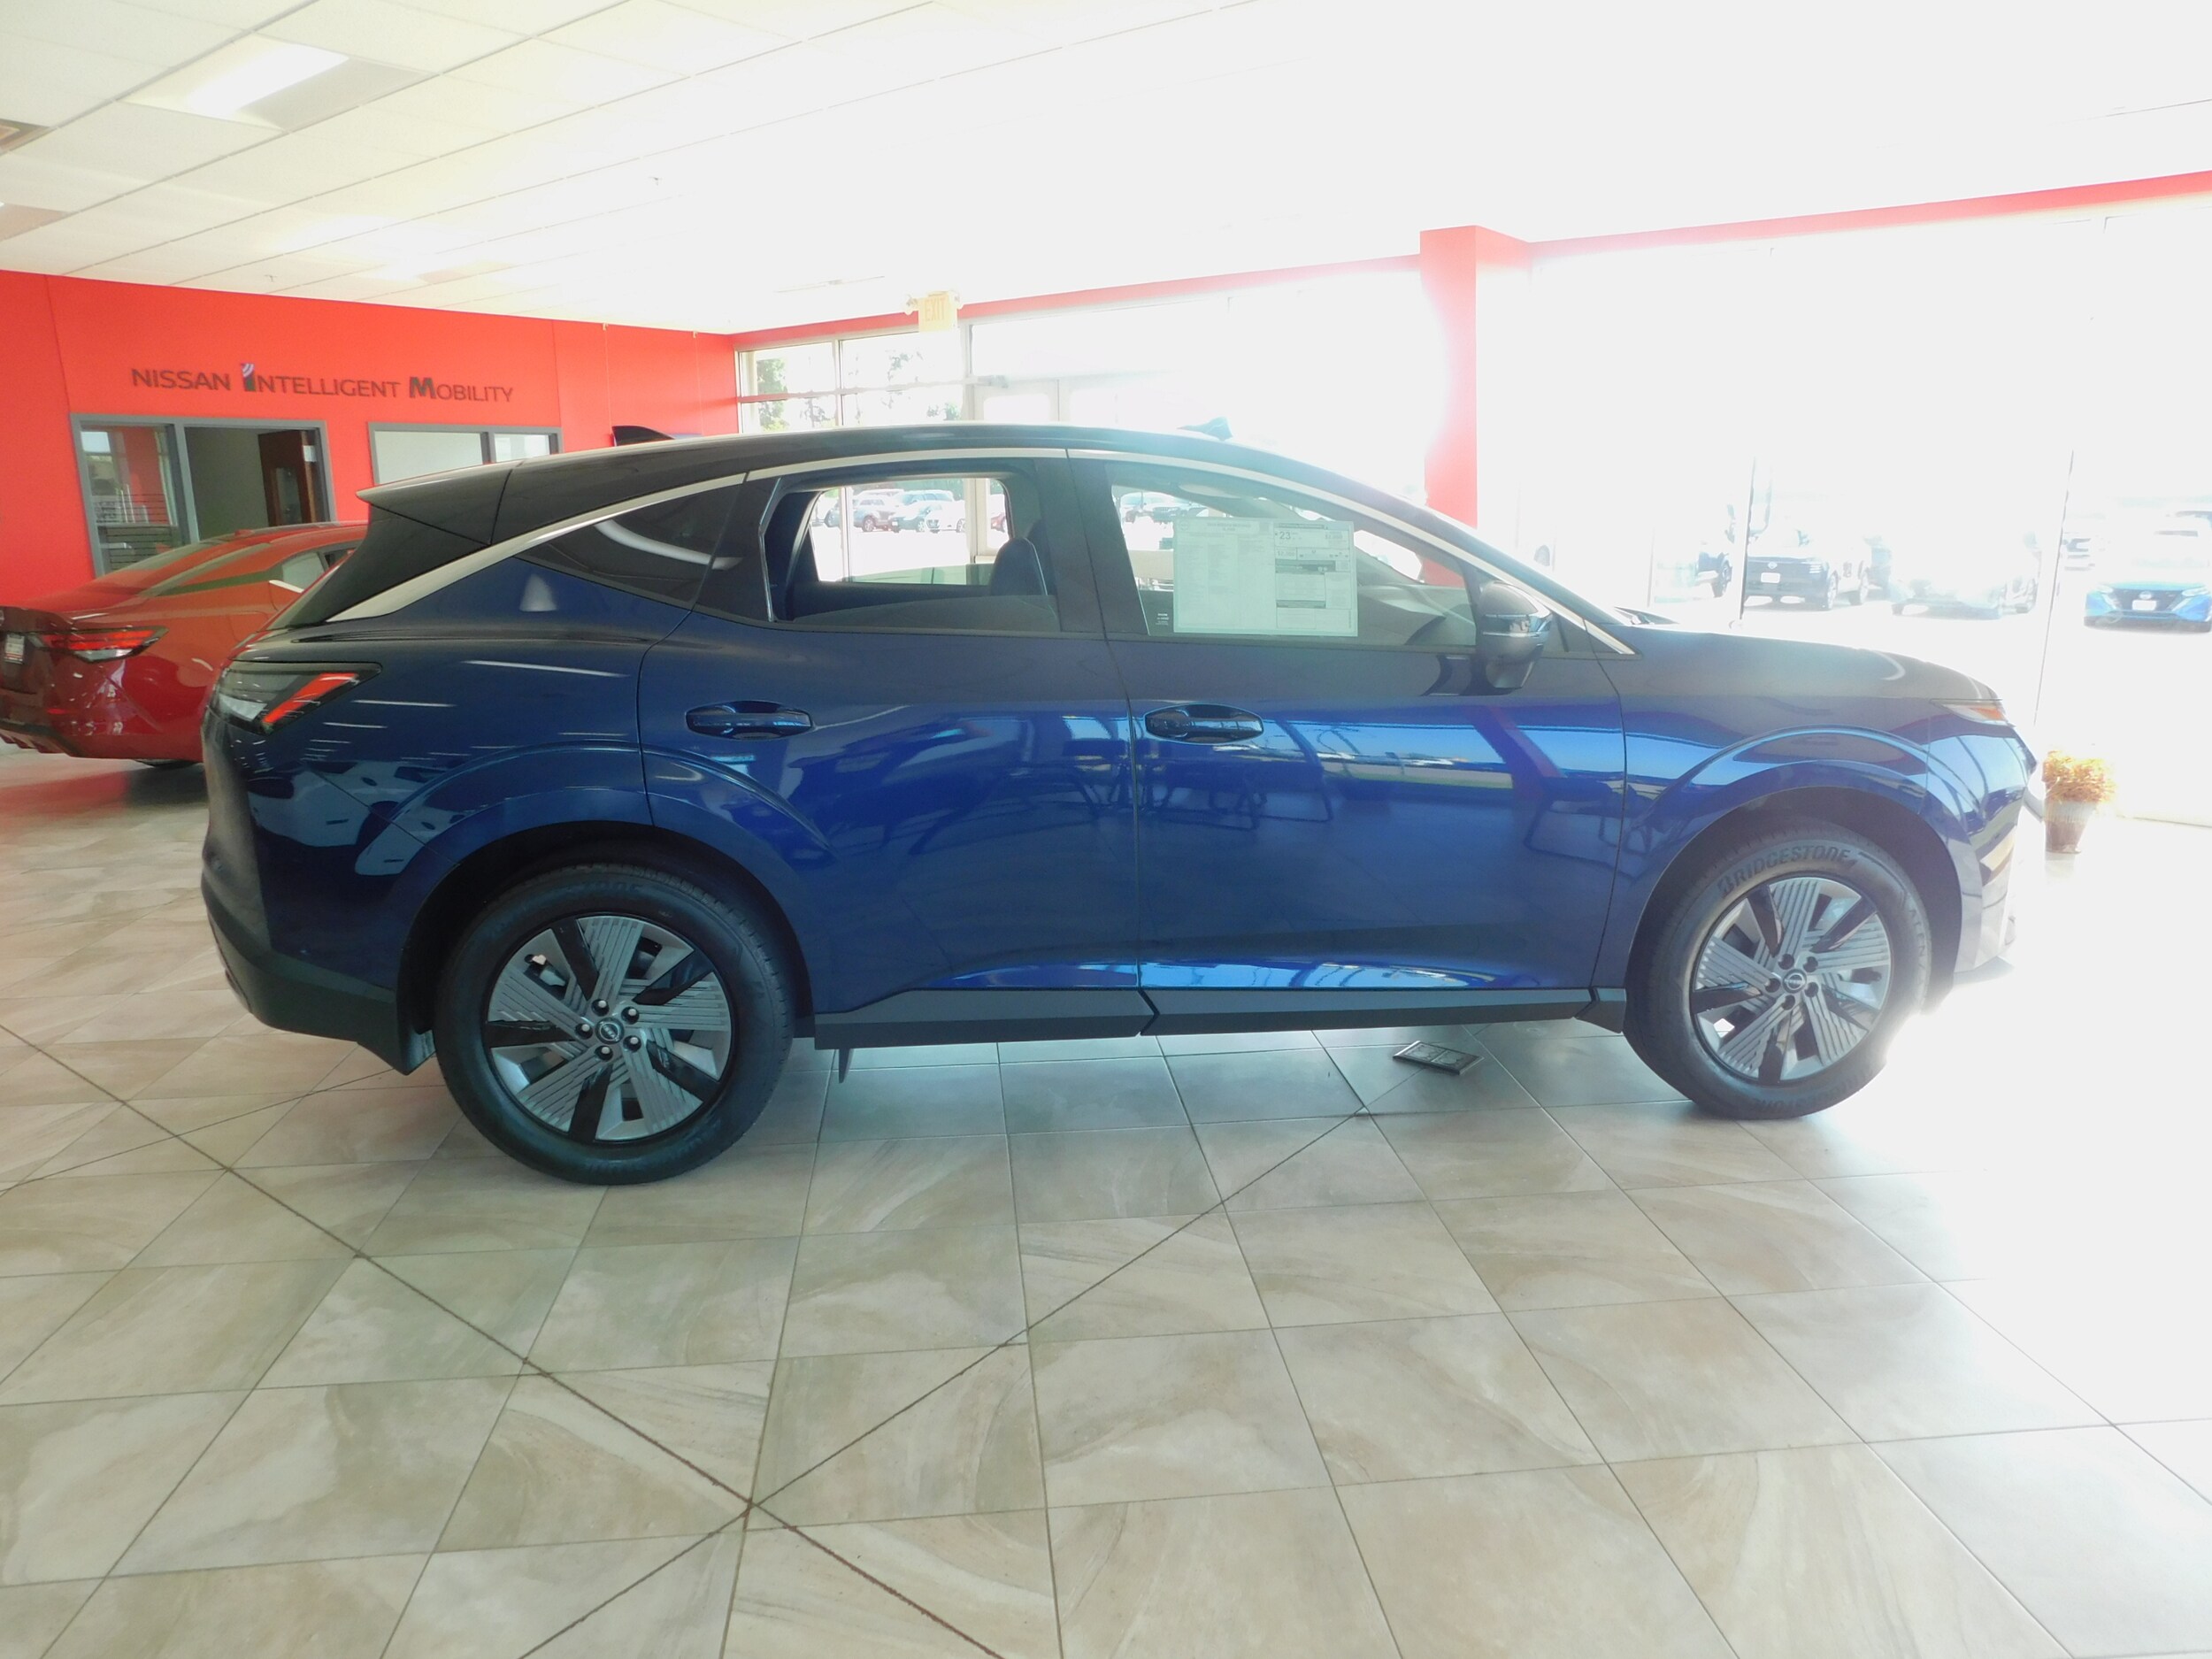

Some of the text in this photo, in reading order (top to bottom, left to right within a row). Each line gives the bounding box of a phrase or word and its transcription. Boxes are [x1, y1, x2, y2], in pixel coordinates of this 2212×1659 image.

[925, 296, 946, 321] EXIT
[131, 363, 513, 403] NISSAN INTELLIGENT MOBILITY
[1279, 531, 1292, 541] 23
[1717, 845, 1853, 898] BRIDGESTONE
